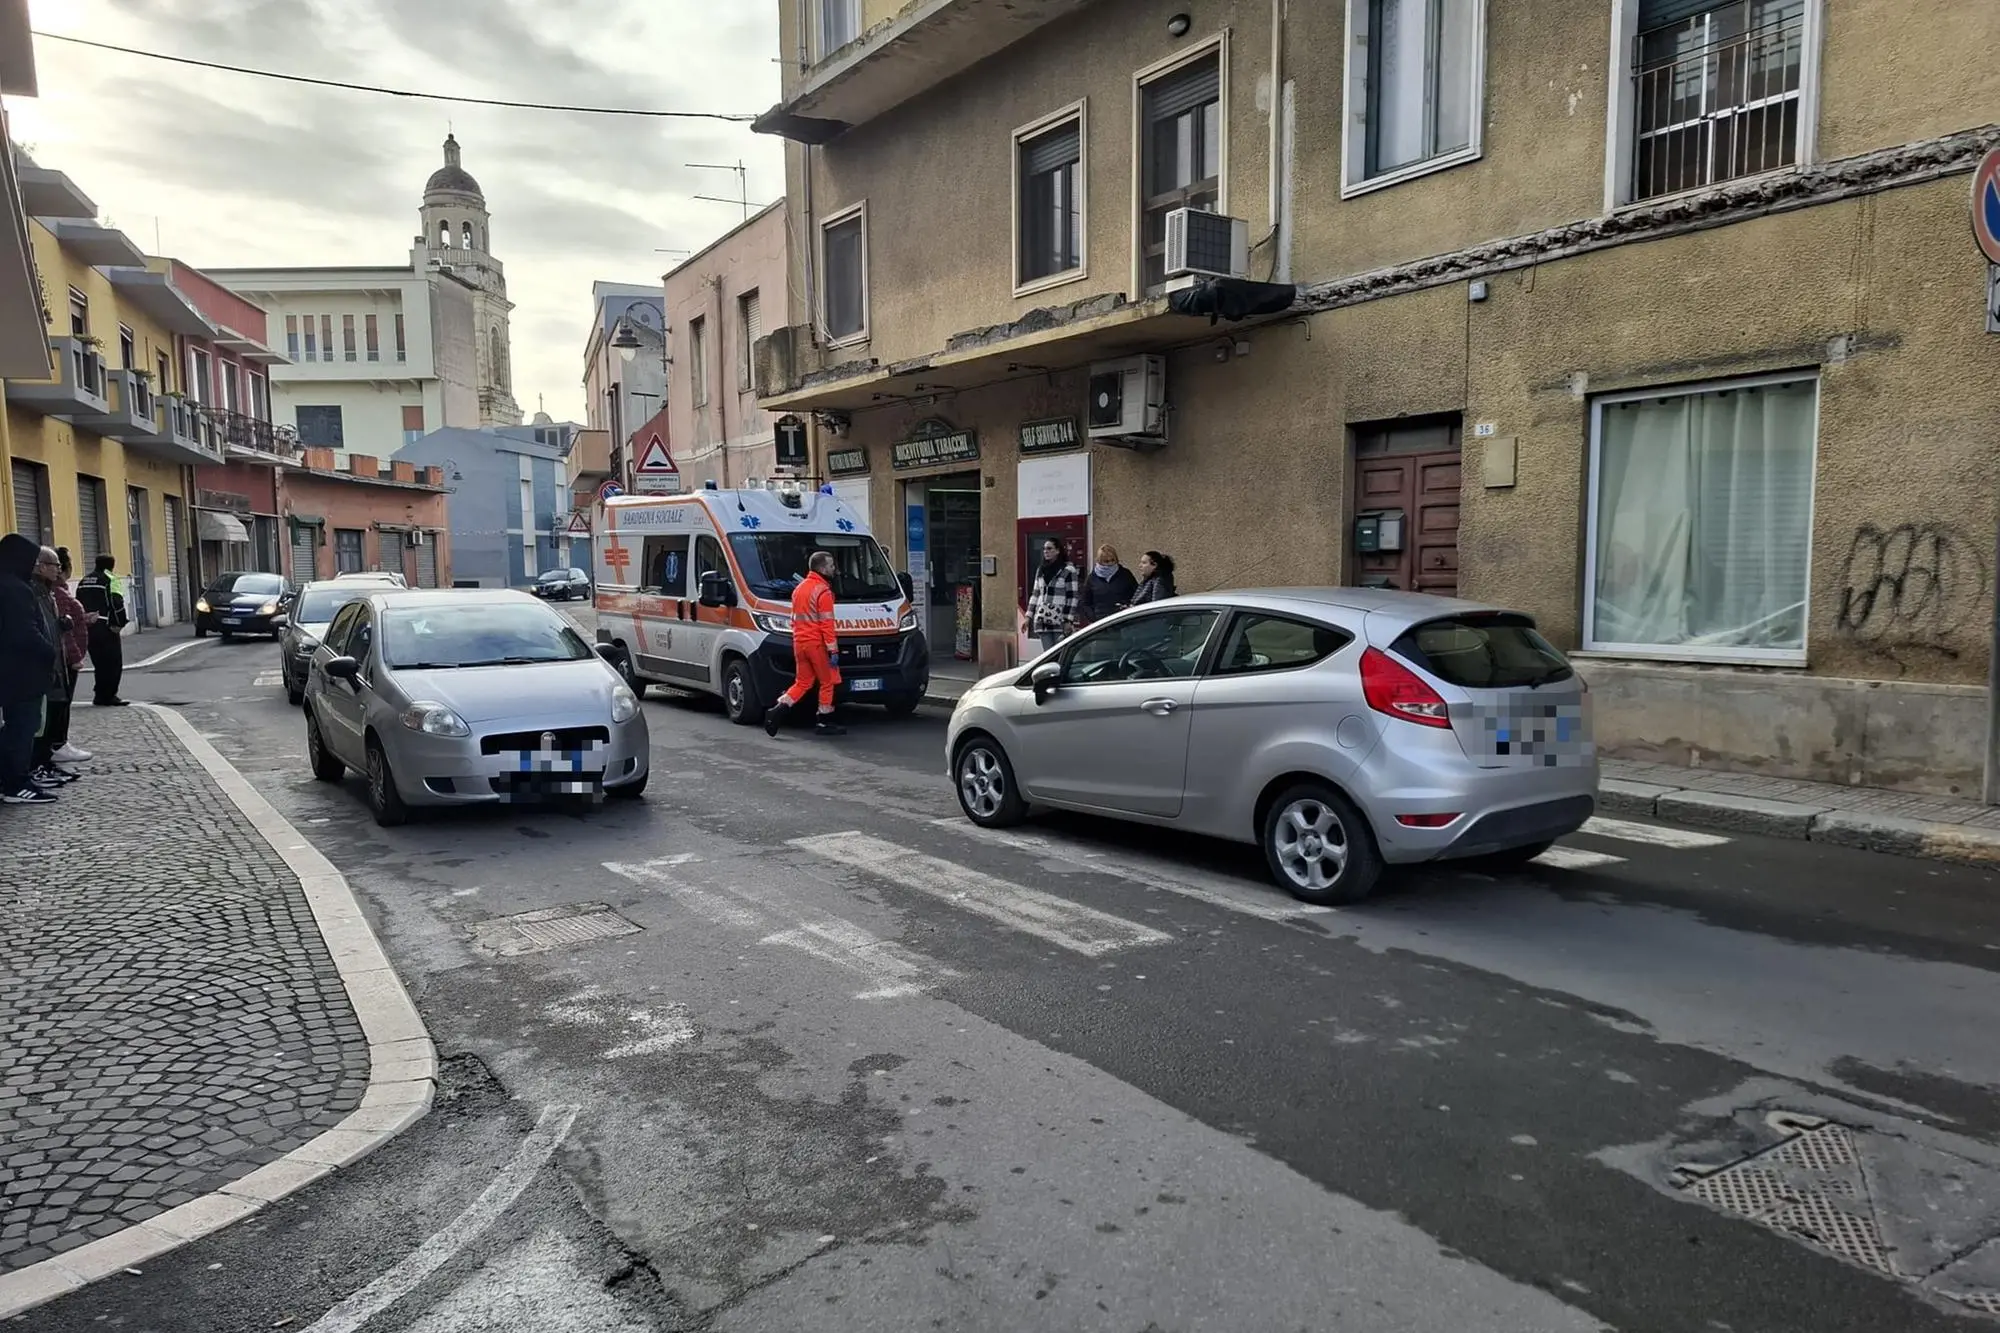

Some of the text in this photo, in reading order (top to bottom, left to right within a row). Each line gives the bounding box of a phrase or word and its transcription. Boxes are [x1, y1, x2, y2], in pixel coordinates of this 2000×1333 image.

[1479, 424, 1489, 434] 36
[781, 425, 800, 455] T
[935, 434, 969, 455] TABACCHI
[623, 511, 656, 525] SARDEGNA
[656, 509, 684, 524] SOCIALE
[856, 645, 872, 658] FIAT
